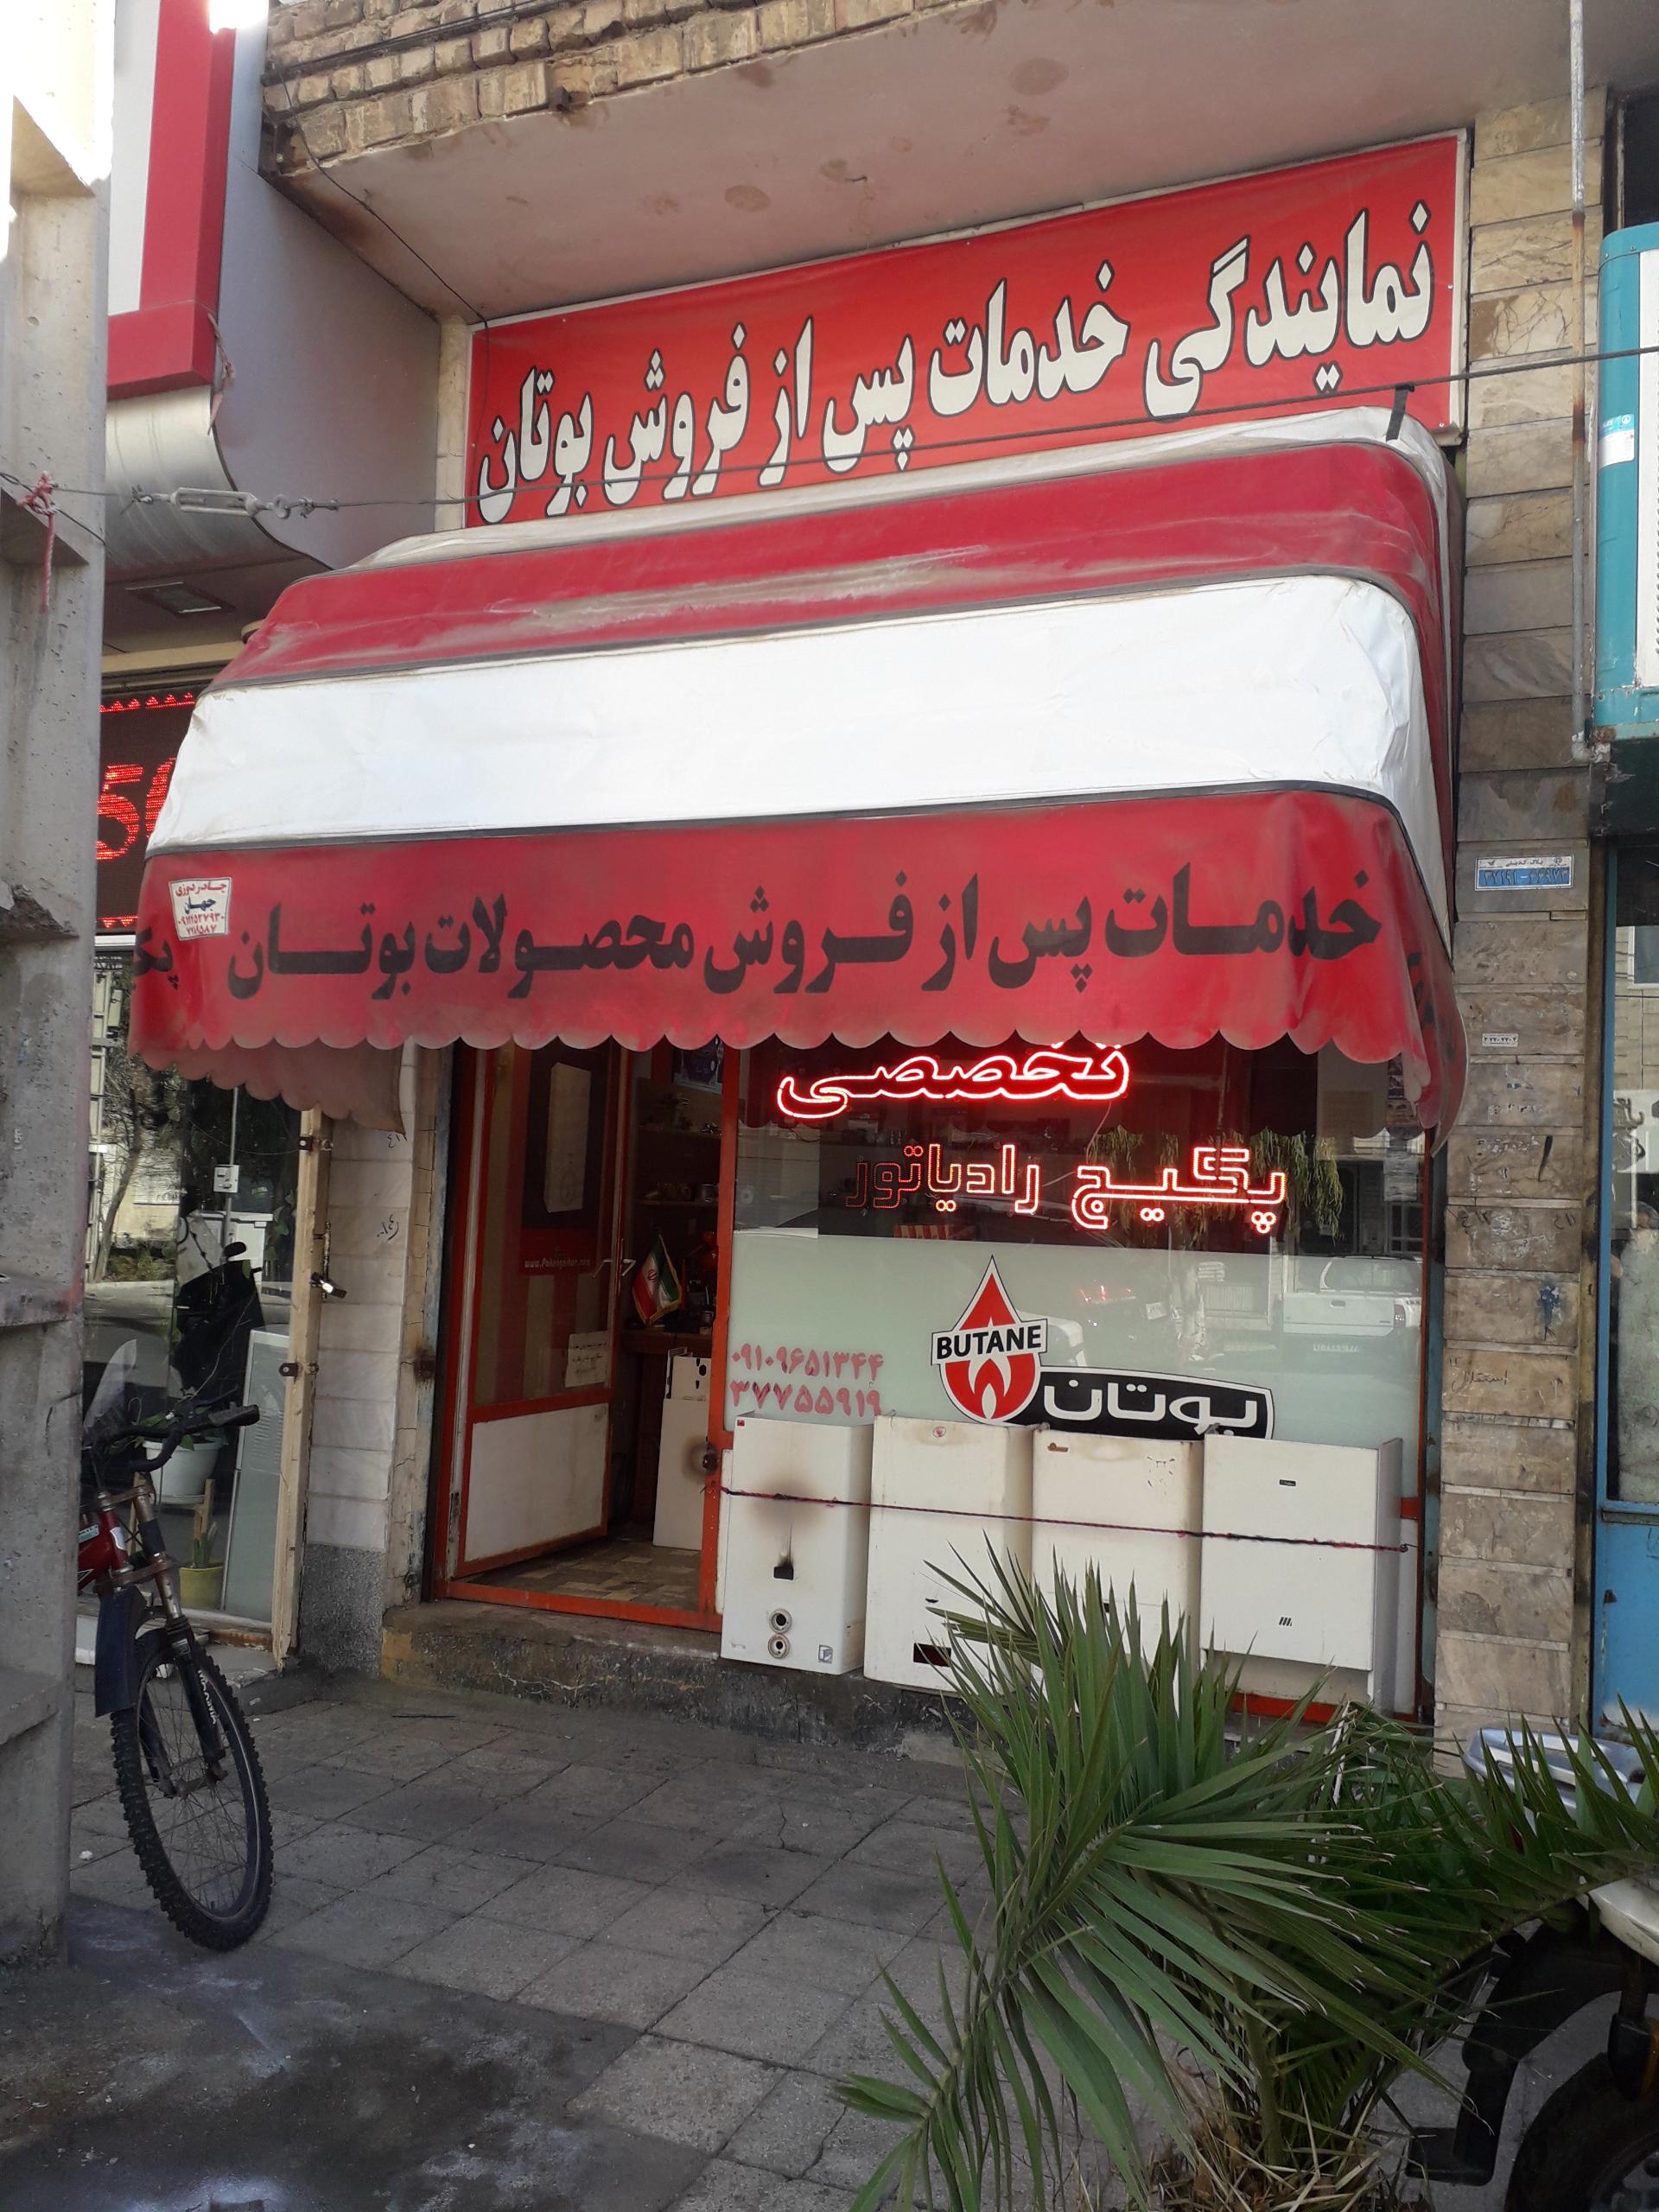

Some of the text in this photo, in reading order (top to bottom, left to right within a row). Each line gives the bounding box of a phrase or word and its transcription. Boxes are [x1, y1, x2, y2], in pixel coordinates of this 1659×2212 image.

[478, 200, 1434, 524] نمایندگی خدمات پس از فروش بوتان
[185, 896, 216, 915] جهان
[228, 861, 1382, 1000] خدمات پس از فروش محصولات بوتان
[846, 1143, 1286, 1233] پکیج رادیاتور
[937, 1325, 1042, 1359] BUTANE
[730, 1380, 881, 1417] ۳۷۷۵۵۹۱۹
[1044, 1379, 1258, 1437] بوتان
